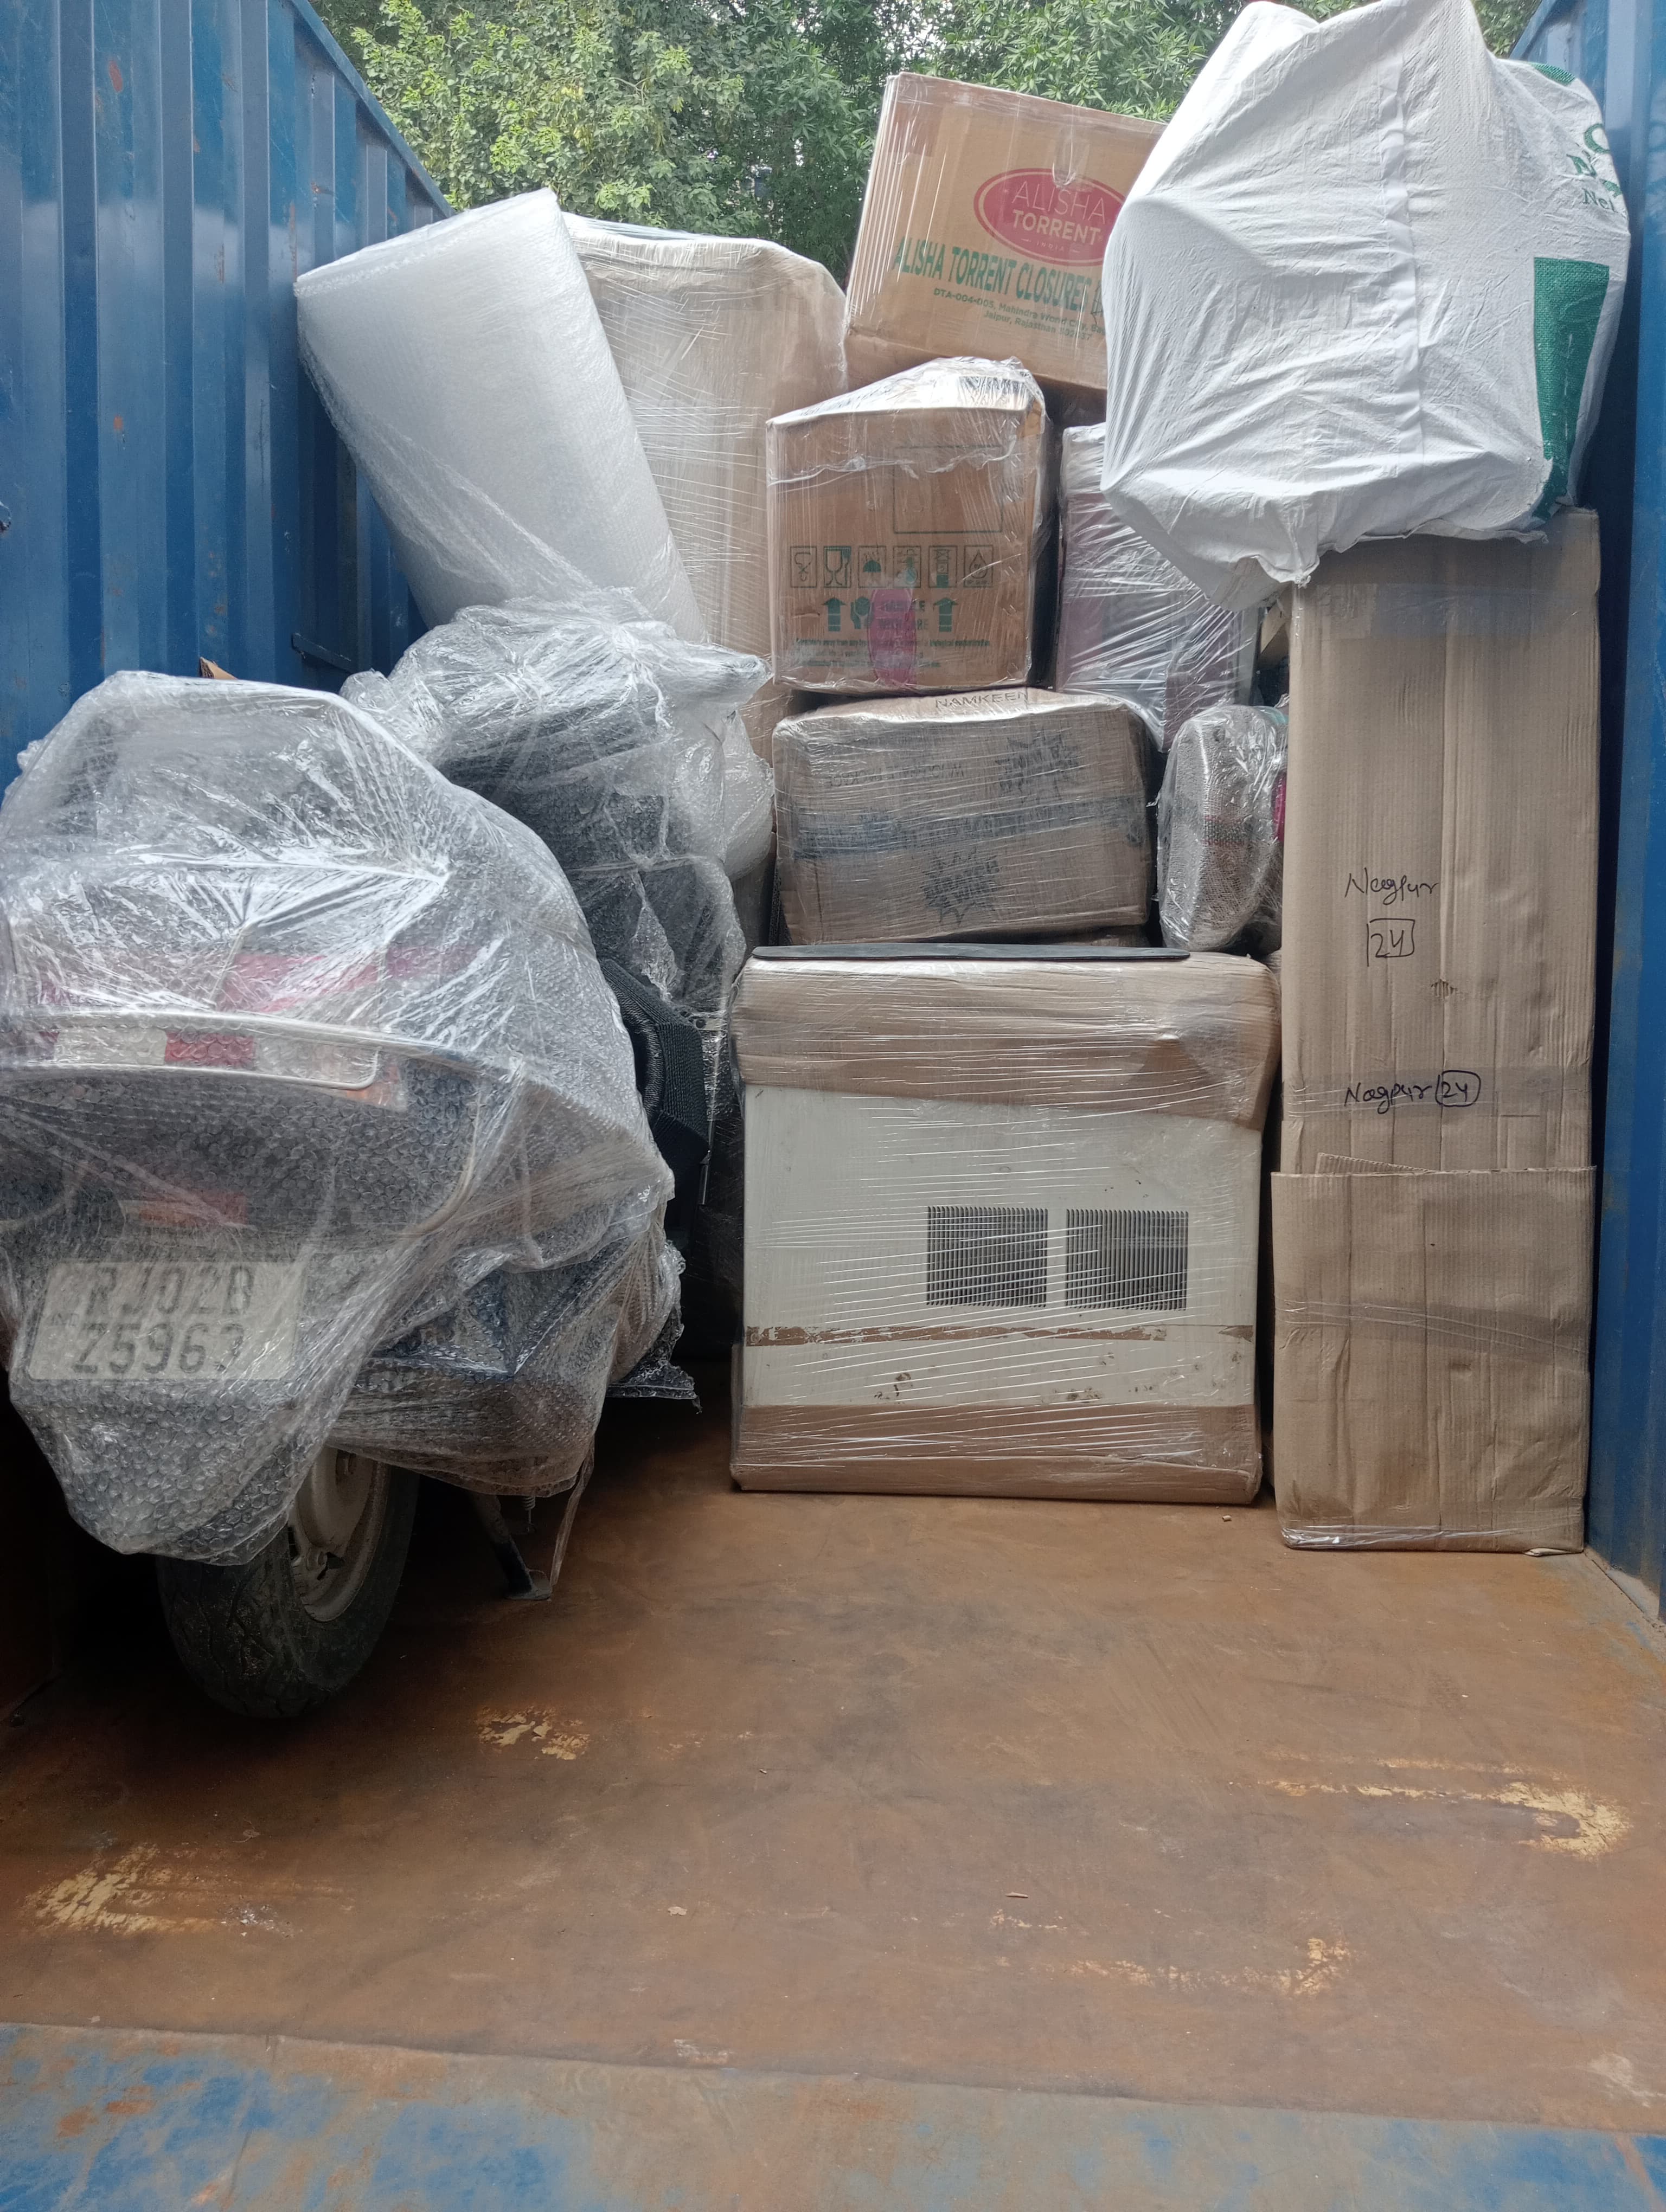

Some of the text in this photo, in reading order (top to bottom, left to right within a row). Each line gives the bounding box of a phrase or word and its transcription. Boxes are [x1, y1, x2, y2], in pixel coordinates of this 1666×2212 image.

[1011, 181, 1106, 225] ALISHA
[1012, 209, 1101, 245] TORRENT
[1036, 241, 1065, 252] INDIA
[892, 236, 946, 280] ALISHA
[947, 246, 1017, 295] TORRENT
[1015, 262, 1092, 312] CLOSURES
[933, 288, 996, 310] DTA-004-005,
[998, 303, 1038, 318] Mahindra
[983, 310, 1012, 325] Jaipur,
[1015, 317, 1056, 334] Rajasthan
[935, 690, 1029, 708] NAMKEEN
[1370, 929, 1405, 957] 24
[1344, 1081, 1468, 1114] Nagpur 24
